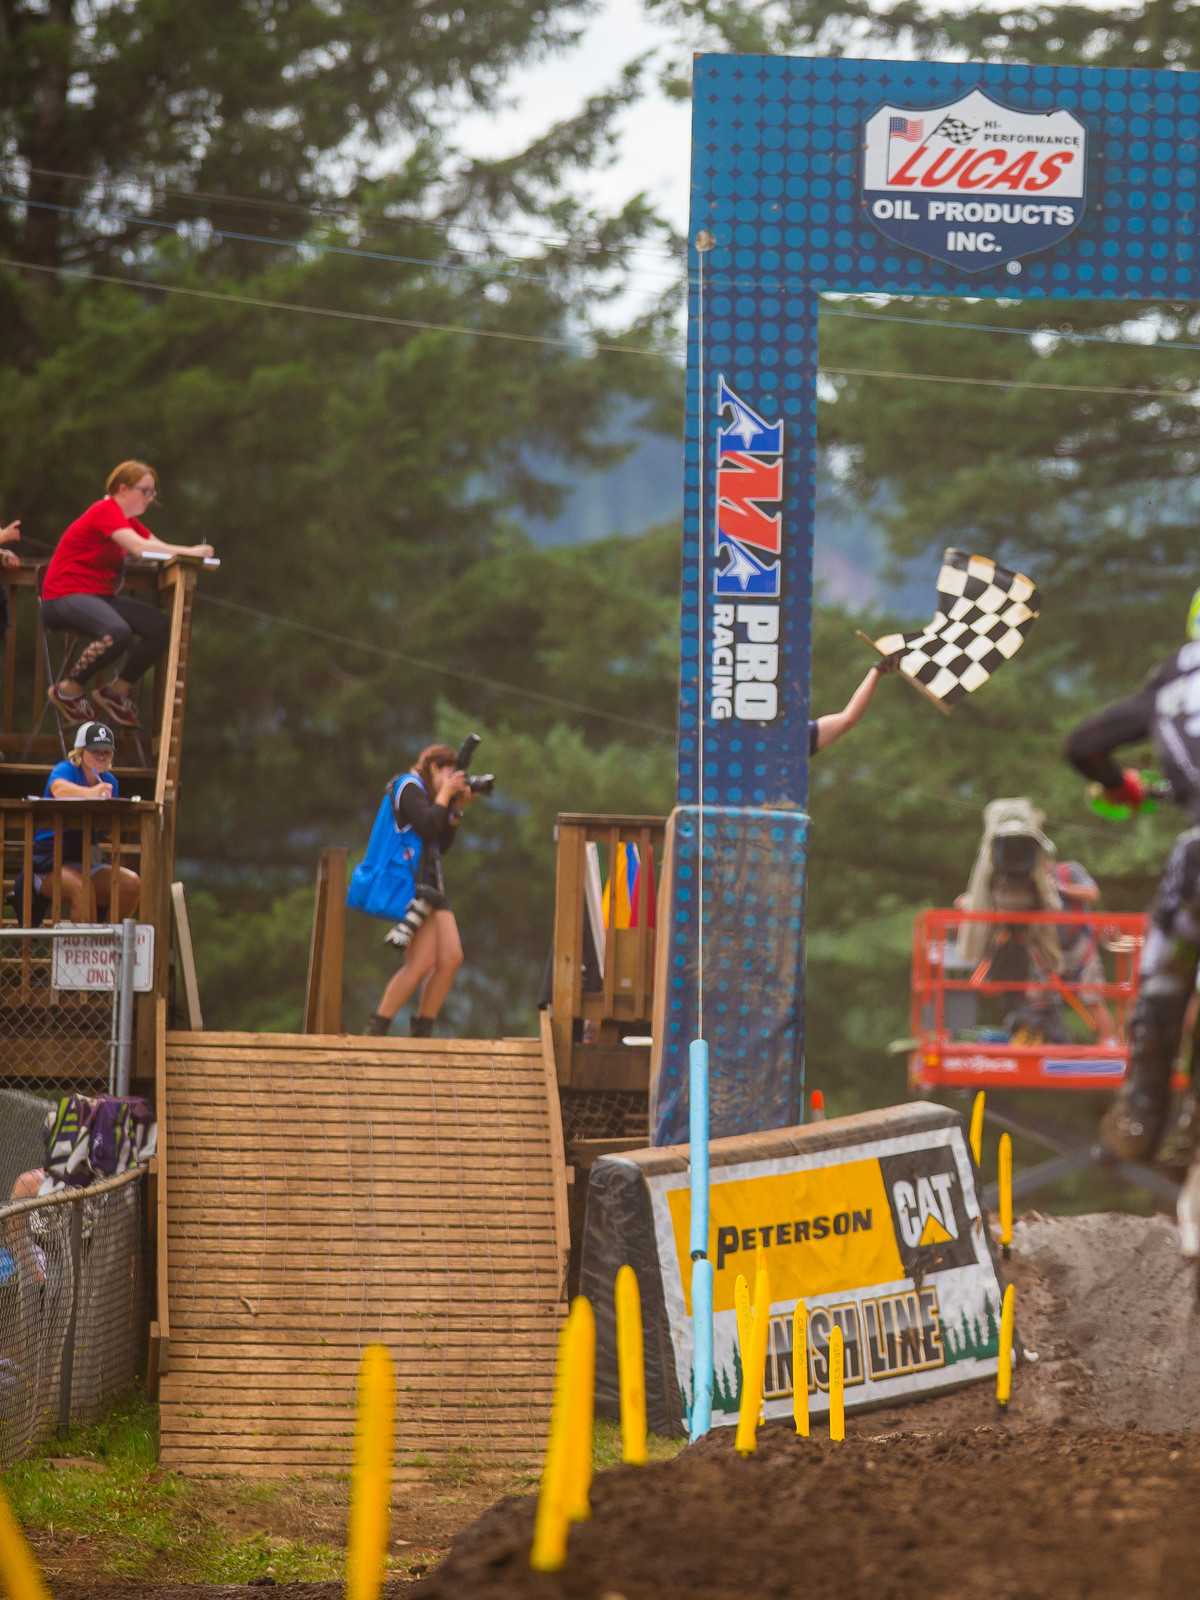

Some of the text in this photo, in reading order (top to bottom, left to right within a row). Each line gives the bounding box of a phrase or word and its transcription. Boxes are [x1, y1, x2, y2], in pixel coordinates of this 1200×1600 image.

[887, 146, 1075, 191] LUCAS
[984, 133, 1080, 146] PERFORMANCE
[872, 199, 1075, 226] OIL PRODUCTS
[946, 231, 1003, 252] INC.
[714, 373, 783, 597] AMA
[710, 604, 735, 721] RACING
[735, 604, 780, 721] PRO
[64, 949, 141, 966] PERSONL
[716, 1208, 872, 1270] PETERSON
[892, 1172, 958, 1248] CAT
[861, 1286, 946, 1382] LINE
